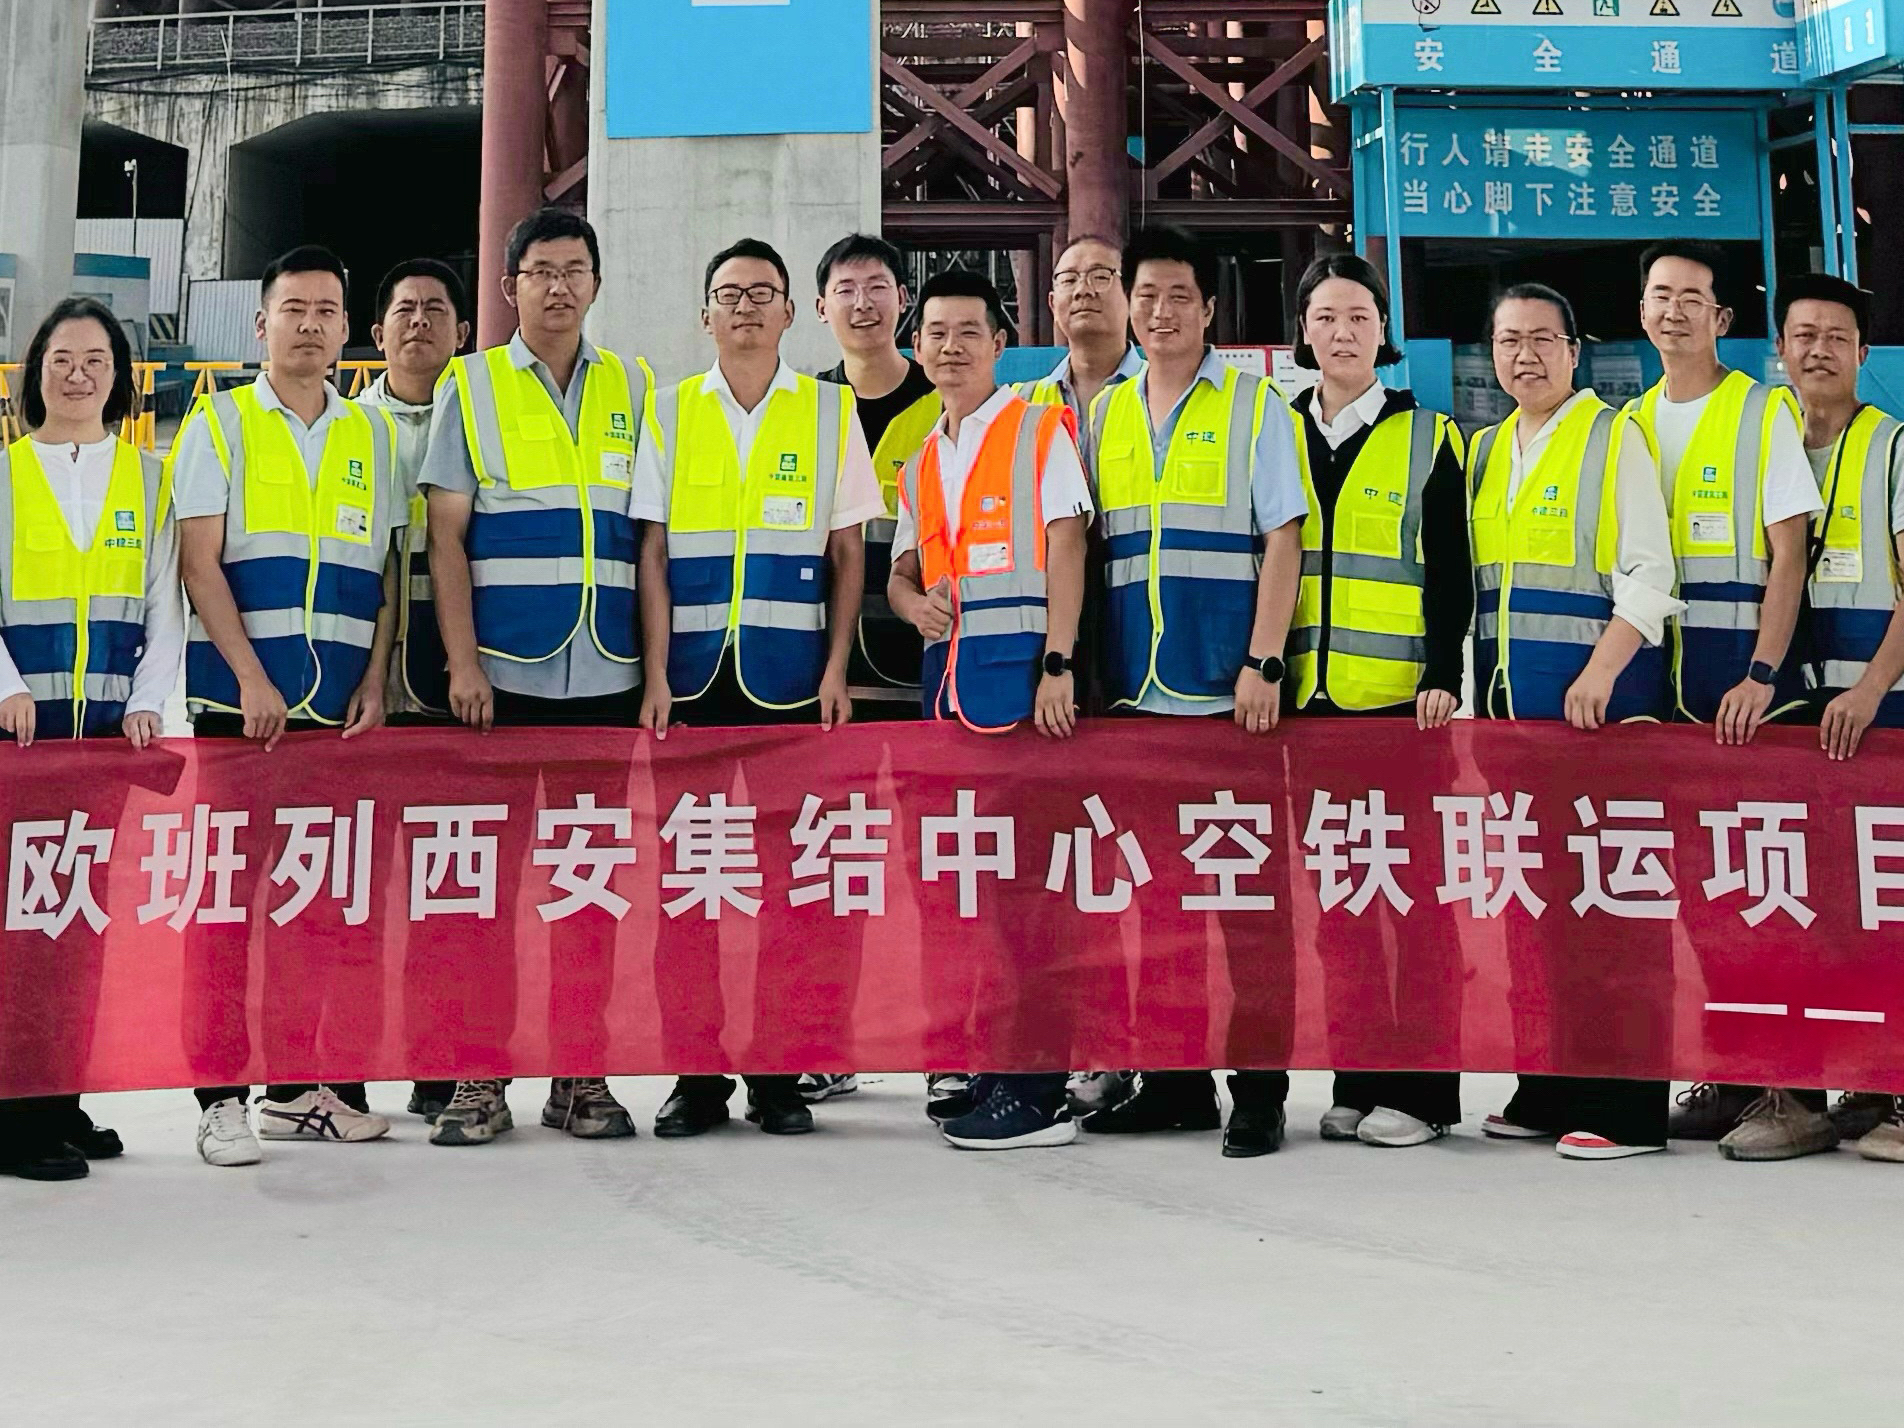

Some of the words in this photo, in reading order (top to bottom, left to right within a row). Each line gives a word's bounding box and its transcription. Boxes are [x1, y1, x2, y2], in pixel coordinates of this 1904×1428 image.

[1413, 38, 1799, 75] 安全通道
[1400, 131, 1721, 170] 行人请走安全通道
[1402, 181, 1723, 218] 当心脚下注意安全
